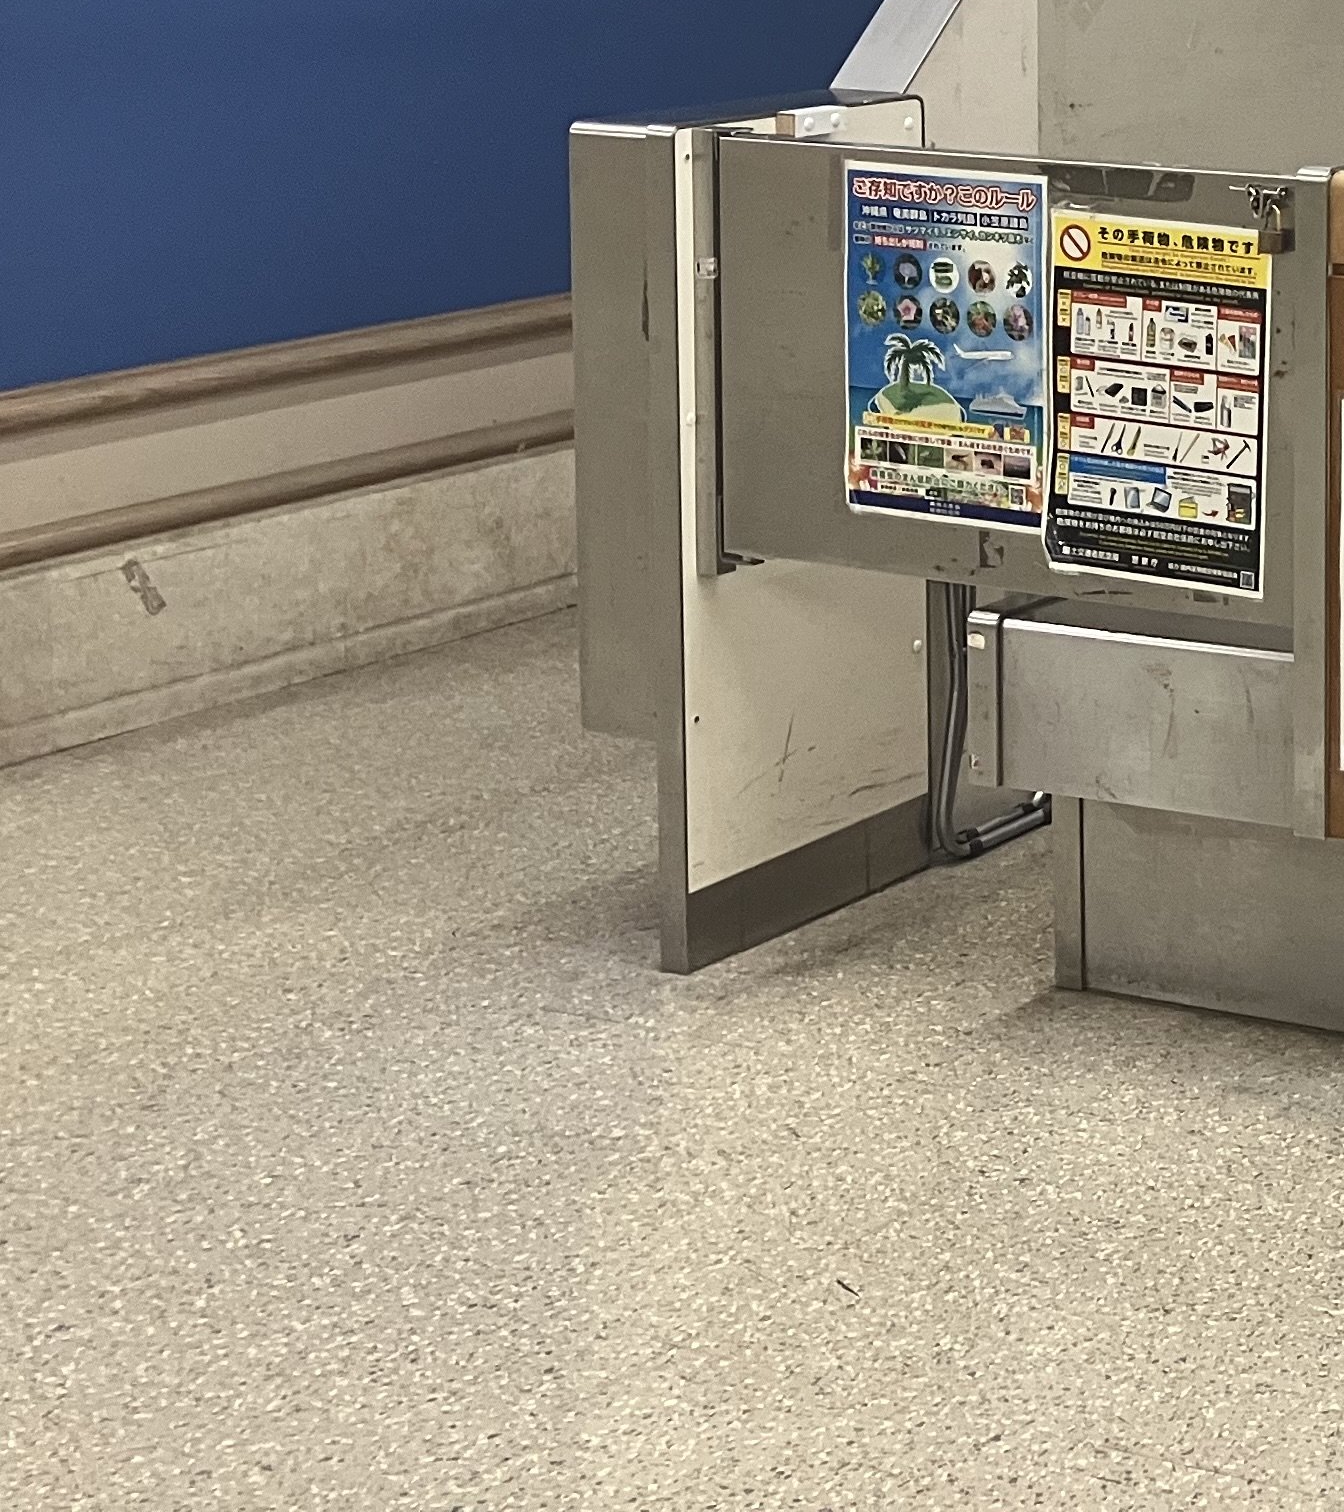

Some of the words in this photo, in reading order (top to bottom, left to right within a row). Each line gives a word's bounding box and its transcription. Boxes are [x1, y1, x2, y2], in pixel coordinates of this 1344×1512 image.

[853, 177, 1036, 211] ご存知ですか？このルール
